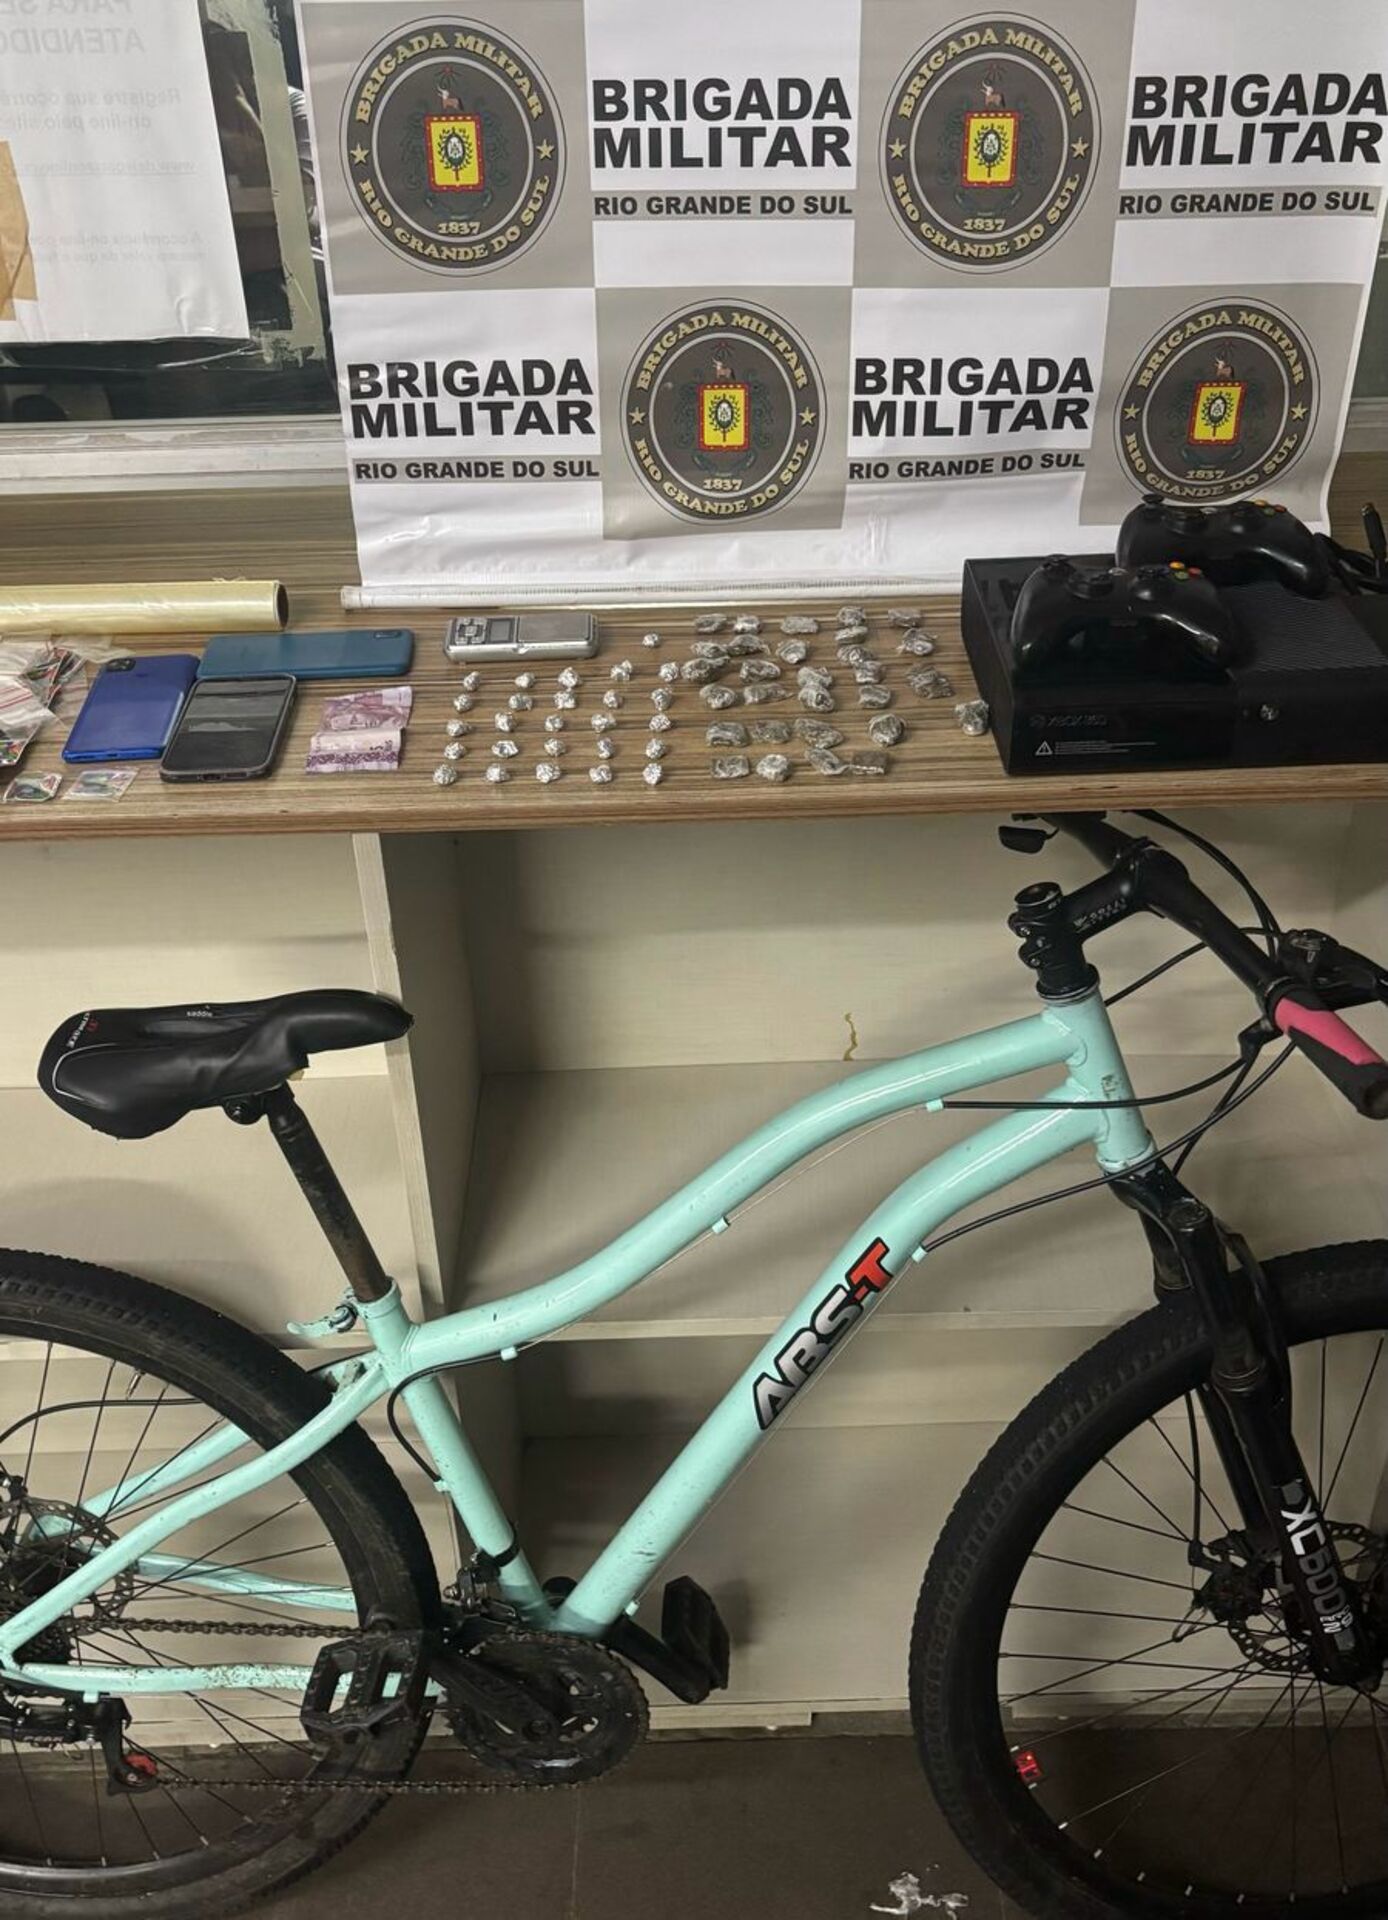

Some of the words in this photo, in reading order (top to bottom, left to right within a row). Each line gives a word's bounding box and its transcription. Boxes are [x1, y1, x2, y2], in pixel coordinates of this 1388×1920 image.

[356, 32, 448, 124] BRIGADA
[454, 32, 543, 120] MILITAR
[899, 28, 998, 120] BRIGADA
[1004, 29, 1083, 118] MILITAR
[593, 78, 851, 121] BRIGADA
[1132, 74, 1388, 118] BRIGADA
[594, 126, 851, 168] MILITAR
[1126, 122, 1382, 166] MILITAR
[359, 179, 392, 228] RIO
[395, 227, 489, 261] GRANDE
[493, 225, 521, 253] DO
[521, 175, 549, 226] SUL
[594, 197, 637, 215] RIO
[647, 196, 750, 214] GRANDE
[761, 196, 794, 214] DO
[804, 196, 852, 214] SUL
[893, 174, 920, 224] RIO
[920, 222, 1010, 258] GRANDE
[1015, 223, 1044, 251] DO
[1046, 174, 1080, 224] SUL
[1120, 195, 1162, 214] RIO
[1171, 193, 1274, 213] GRANDE
[1282, 192, 1316, 210] DO
[1325, 192, 1374, 210] SUL
[438, 221, 481, 235] 1837
[963, 218, 1006, 231] 1837
[636, 312, 726, 392] BRIGADA
[731, 312, 808, 389] MILITAR
[1137, 311, 1232, 389] BRIGADA
[1238, 311, 1305, 385] MILITAR
[347, 359, 594, 399] BRIGADA
[855, 358, 1093, 396] BRIGADA
[351, 400, 595, 438] MILITAR
[852, 398, 1089, 436] MILITAR
[356, 463, 397, 479] RIO
[406, 462, 505, 479] GRANDE
[513, 461, 545, 478] DO
[554, 461, 599, 478] SUL
[635, 438, 663, 482] RIO
[663, 481, 748, 515] GRANDE
[752, 483, 779, 508] DO
[780, 439, 809, 485] SUL
[703, 478, 743, 491] 1837
[850, 462, 889, 479] RIO
[897, 458, 994, 477] GRANDE
[1002, 455, 1032, 472] DO
[1041, 453, 1085, 469] SUL
[1125, 433, 1147, 473] RIO
[1146, 473, 1224, 497] GRANDE
[1230, 473, 1259, 491] DO
[1263, 433, 1298, 474] SUL
[1186, 469, 1225, 480] 1837
